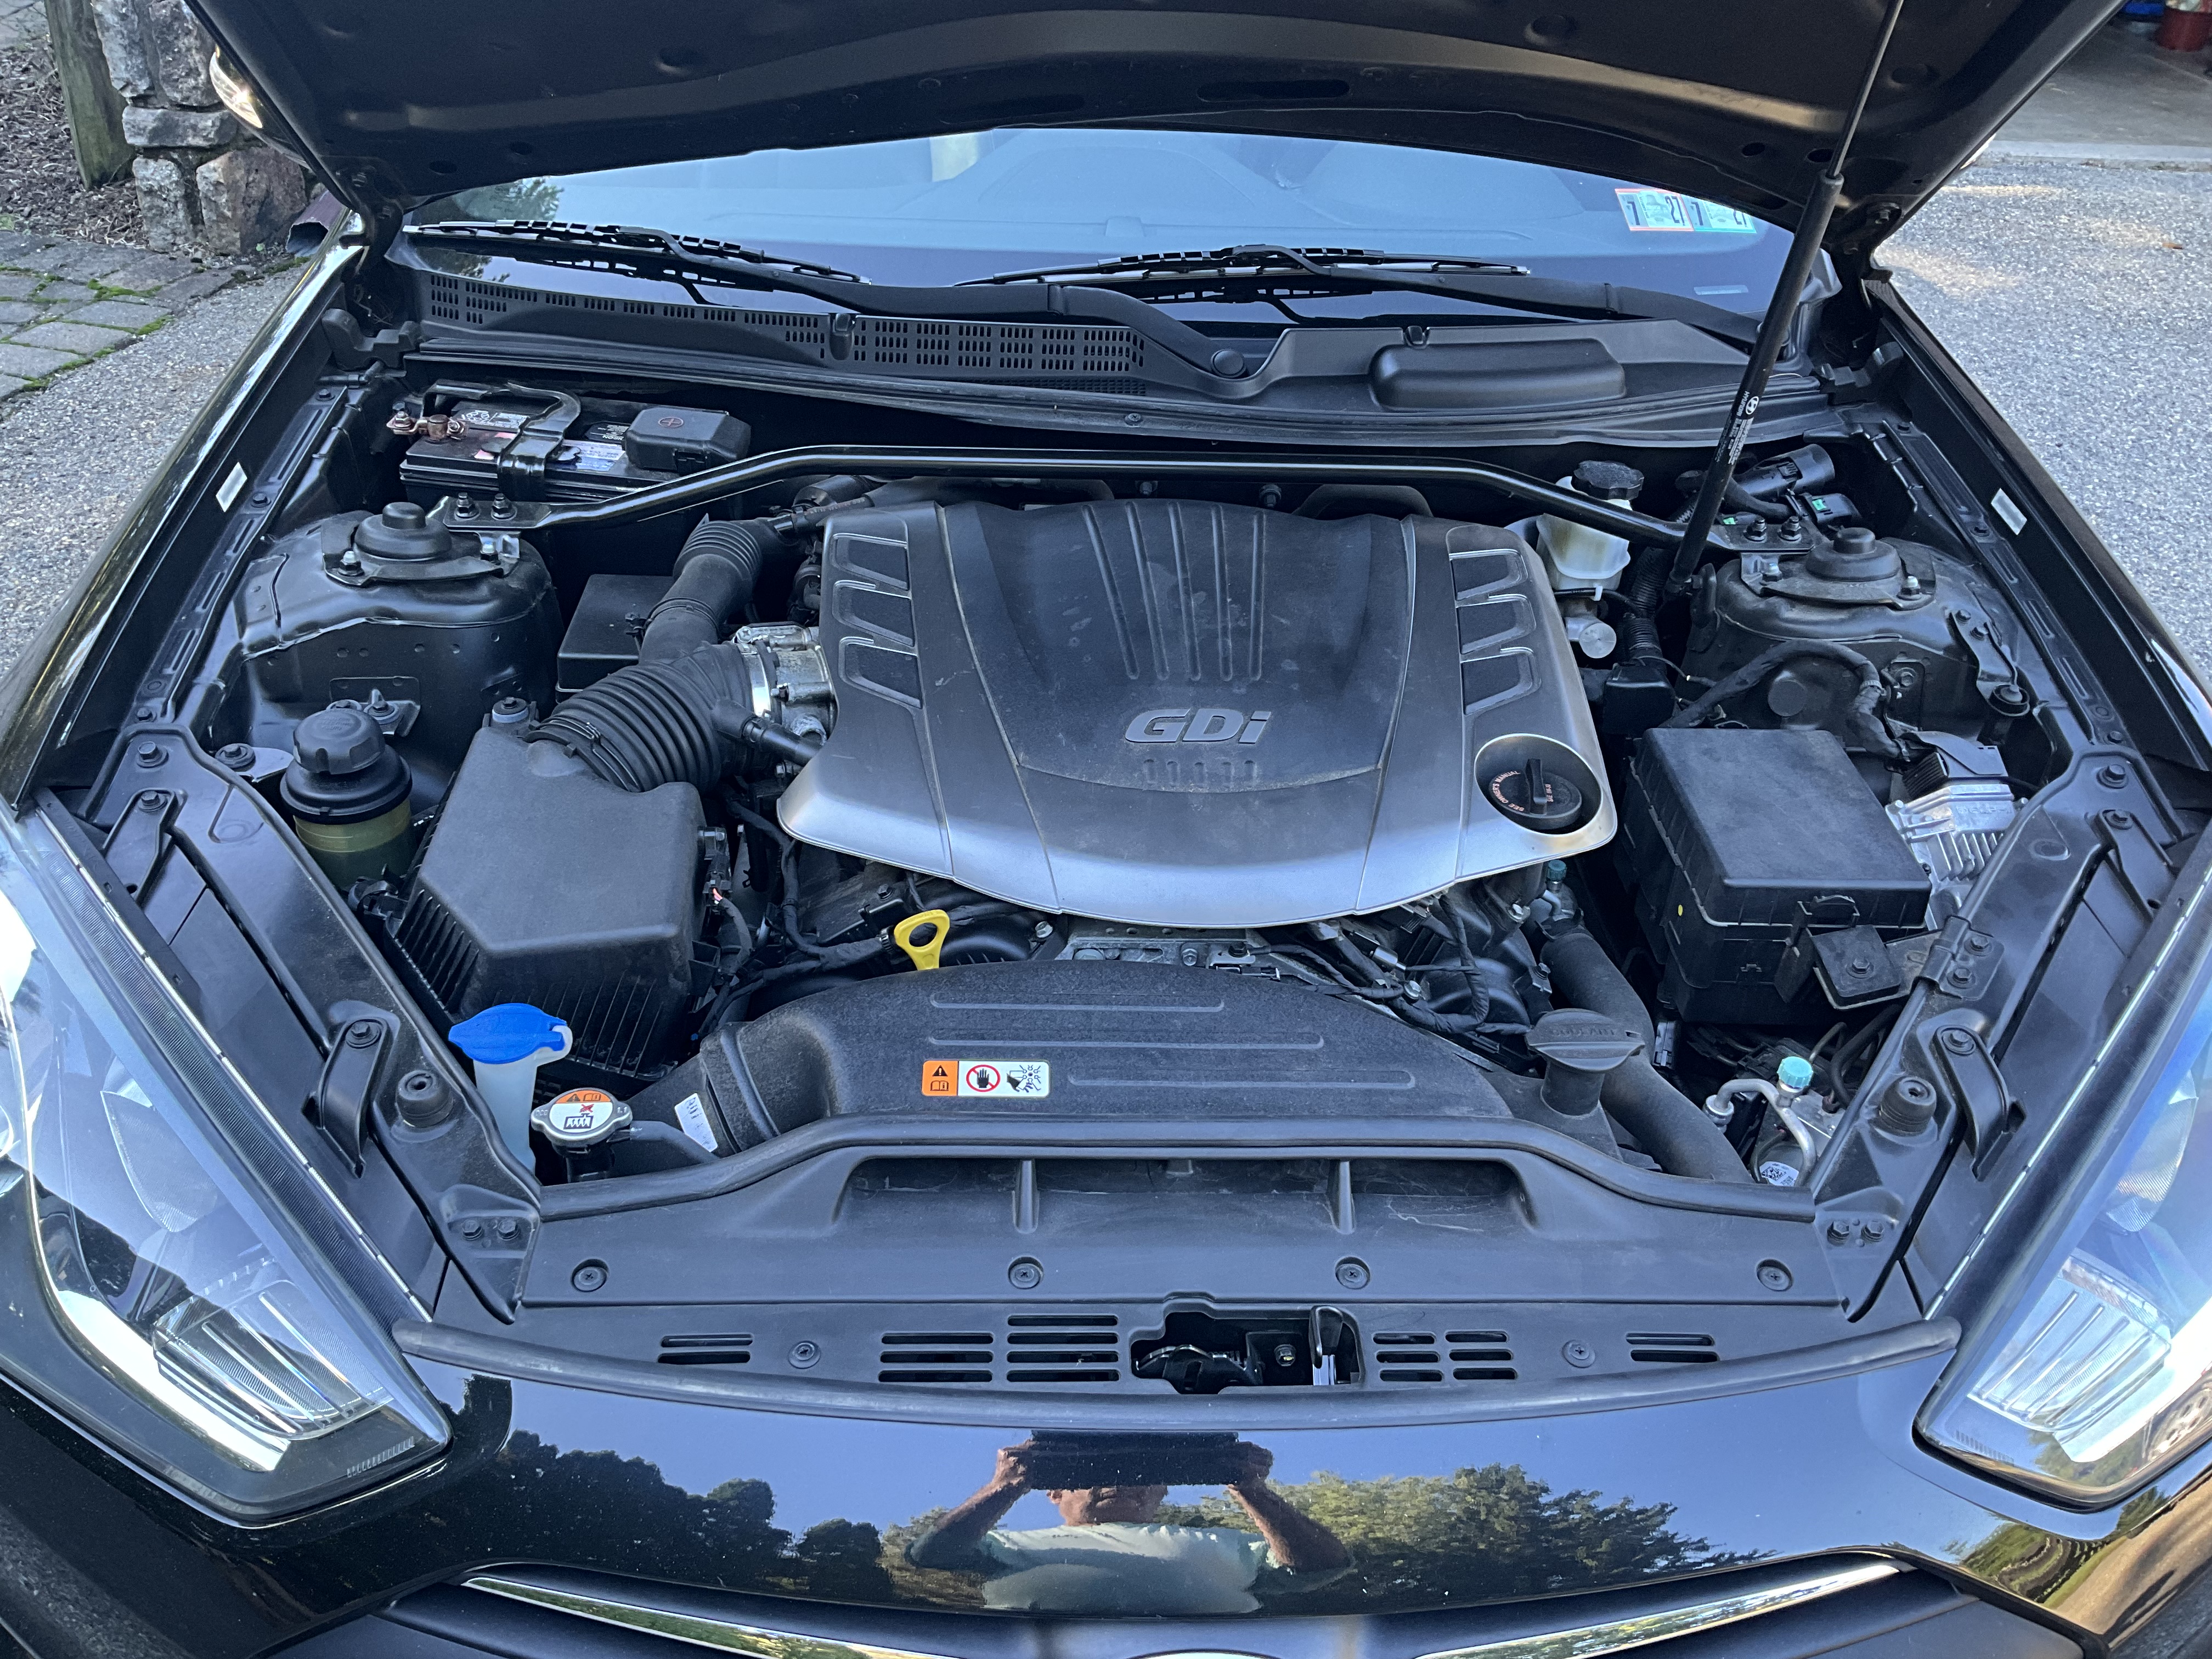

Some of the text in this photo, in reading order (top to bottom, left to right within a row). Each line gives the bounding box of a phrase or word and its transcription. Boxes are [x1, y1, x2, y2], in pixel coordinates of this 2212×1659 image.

[1664, 196, 1685, 226] 27
[1125, 708, 1272, 744] GDi
[1492, 770, 1525, 811] SEE OWNER'S MANUAL
